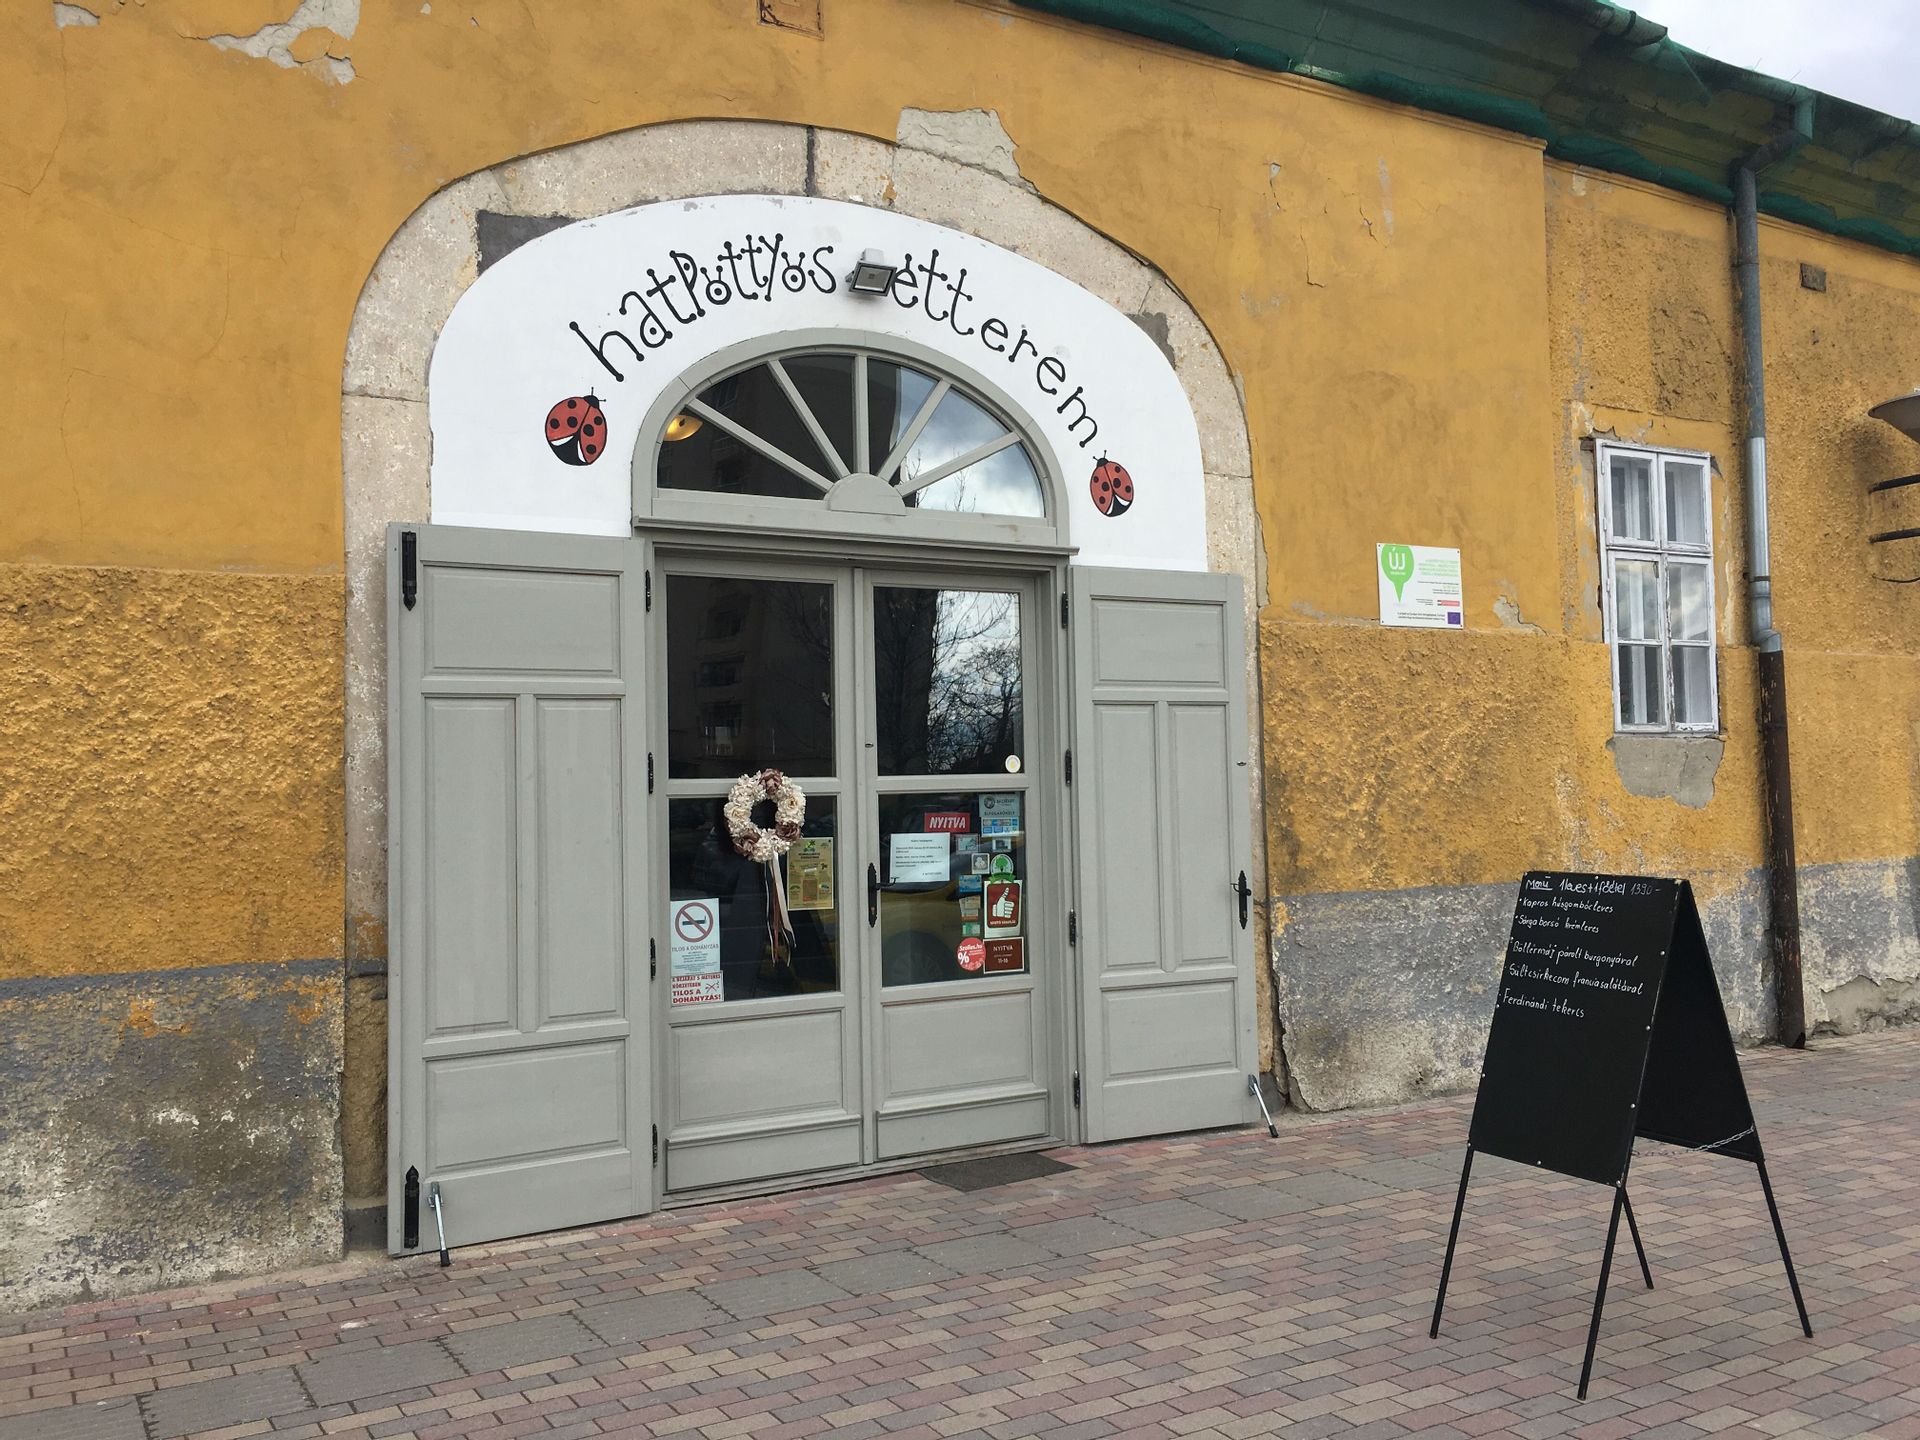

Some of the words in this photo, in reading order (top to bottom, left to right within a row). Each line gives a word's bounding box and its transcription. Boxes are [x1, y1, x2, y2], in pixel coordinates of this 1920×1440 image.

[929, 816, 966, 829] NYITVA
[1522, 896, 1549, 909] Kapros
[992, 944, 1014, 952] NYITVA
[1584, 949, 1639, 968] burgonyával
[1502, 987, 1550, 1010] Ferdinándi
[1551, 997, 1586, 1018] tekercs
